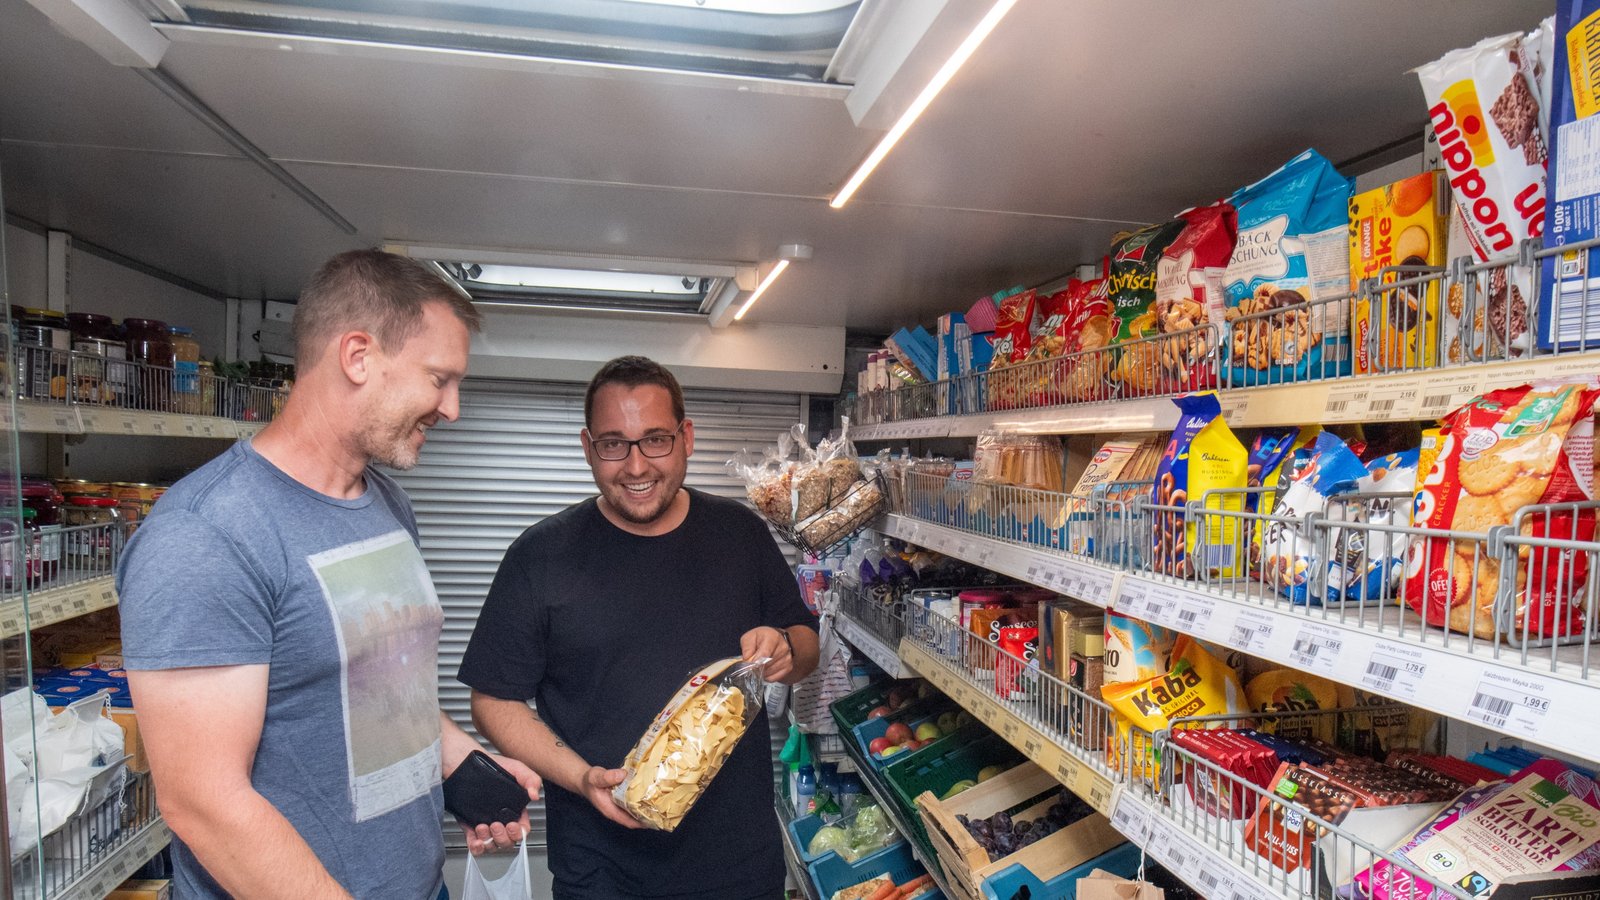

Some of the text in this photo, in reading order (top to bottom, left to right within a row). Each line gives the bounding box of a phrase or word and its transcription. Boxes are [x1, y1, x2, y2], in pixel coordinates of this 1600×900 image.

[1429, 101, 1513, 251] nippon
[1237, 229, 1272, 248] BÄCK
[1363, 219, 1371, 257] ORANGE
[1231, 242, 1278, 265] SCHUNG
[1458, 385, 1469, 393] 1,92
[1201, 453, 1231, 463] Bahlsen
[1432, 479, 1451, 527] CRACKER
[1325, 640, 1335, 648] 1,99
[1404, 662, 1418, 672] 1,79
[1131, 667, 1202, 717] Kaba
[1522, 696, 1548, 709] 1,99 €
[1286, 769, 1345, 802] NUSSKLASSE
[1394, 758, 1464, 792] NUSSKLASSE
[1526, 789, 1553, 808] EDEKA
[1496, 794, 1584, 848] ZART
[1553, 803, 1598, 829] Bio
[1465, 826, 1527, 870] SCHWEIZER TRADITION
[1473, 815, 1548, 866] SCHOKOLADE
[1478, 830, 1521, 860] CONCHIERT NACH
[1481, 807, 1562, 861] BITTER
[1490, 854, 1516, 874] Handel
